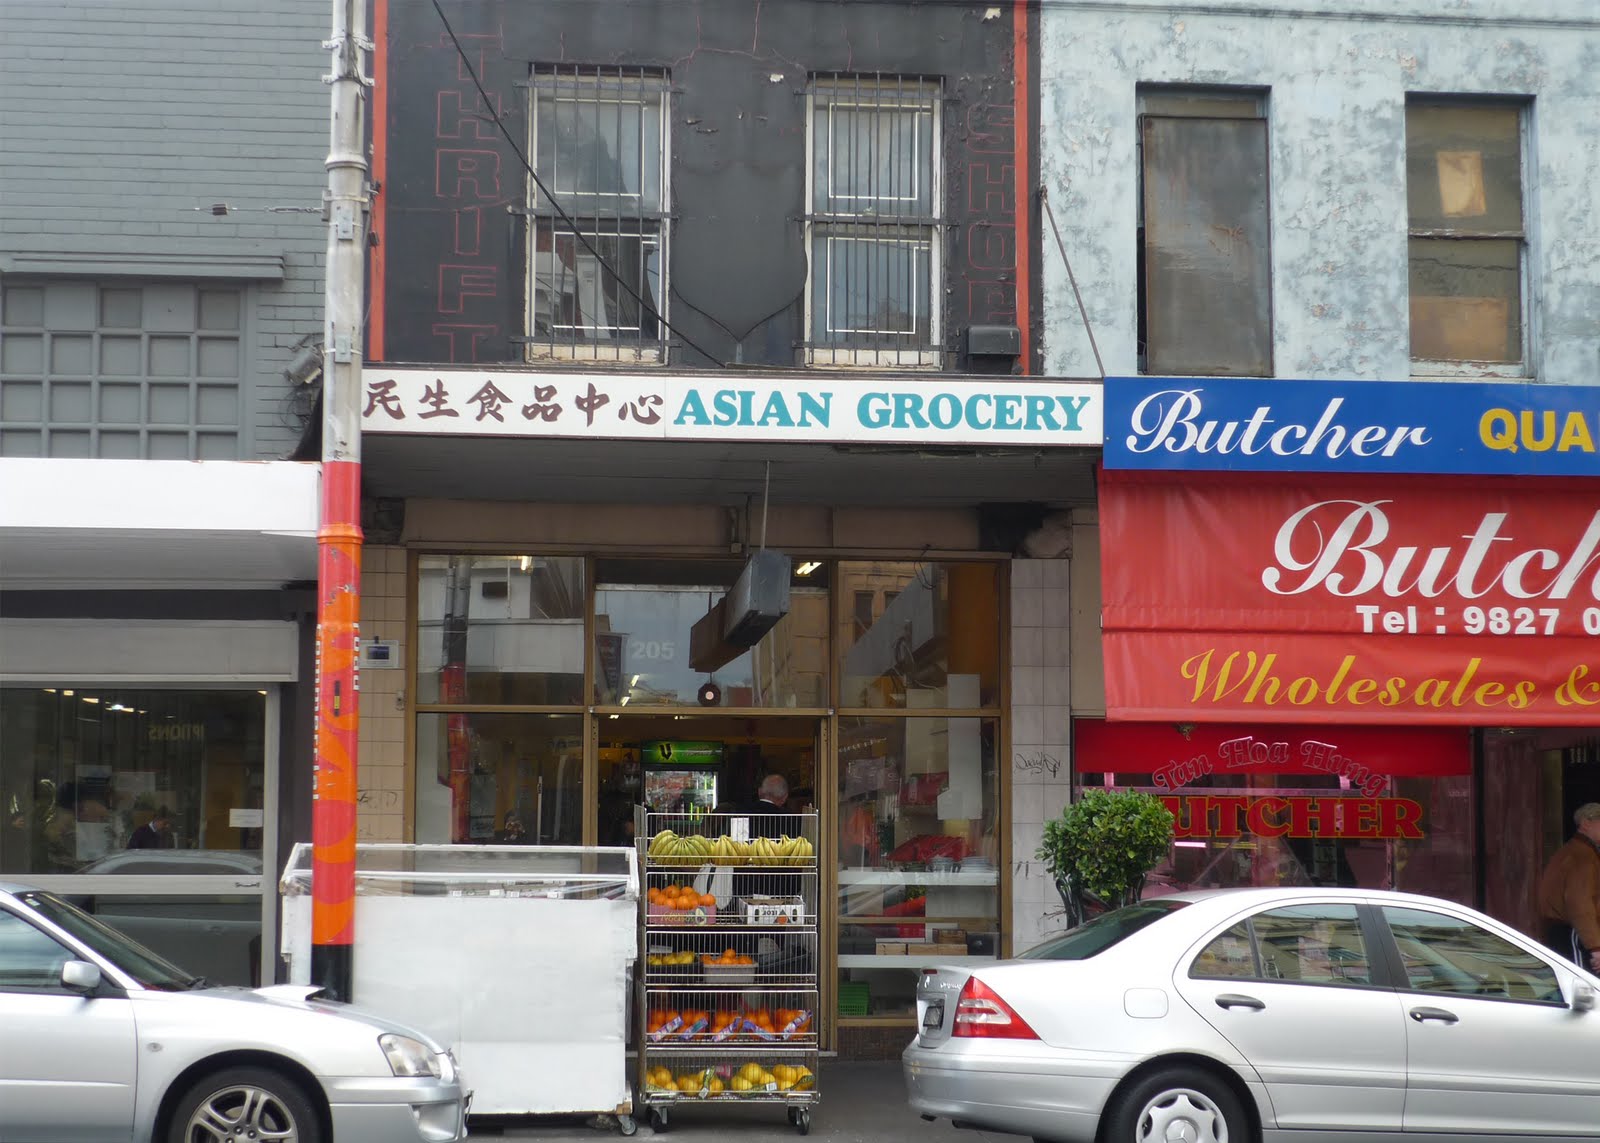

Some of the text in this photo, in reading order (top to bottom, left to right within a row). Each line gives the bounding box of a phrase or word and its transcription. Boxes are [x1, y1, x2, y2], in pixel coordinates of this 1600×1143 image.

[362, 378, 664, 427] 民生食品中心
[673, 389, 1091, 431] ASIAN GROCERY
[1126, 388, 1600, 459] Butcher QUA
[1356, 605, 1417, 634] Tel
[1463, 606, 1560, 635] 9827
[631, 641, 674, 659] 205
[1180, 649, 1542, 709] Wholesales
[1152, 736, 1389, 799] Tan Hoa Hung
[1160, 796, 1425, 840] UTCHER
